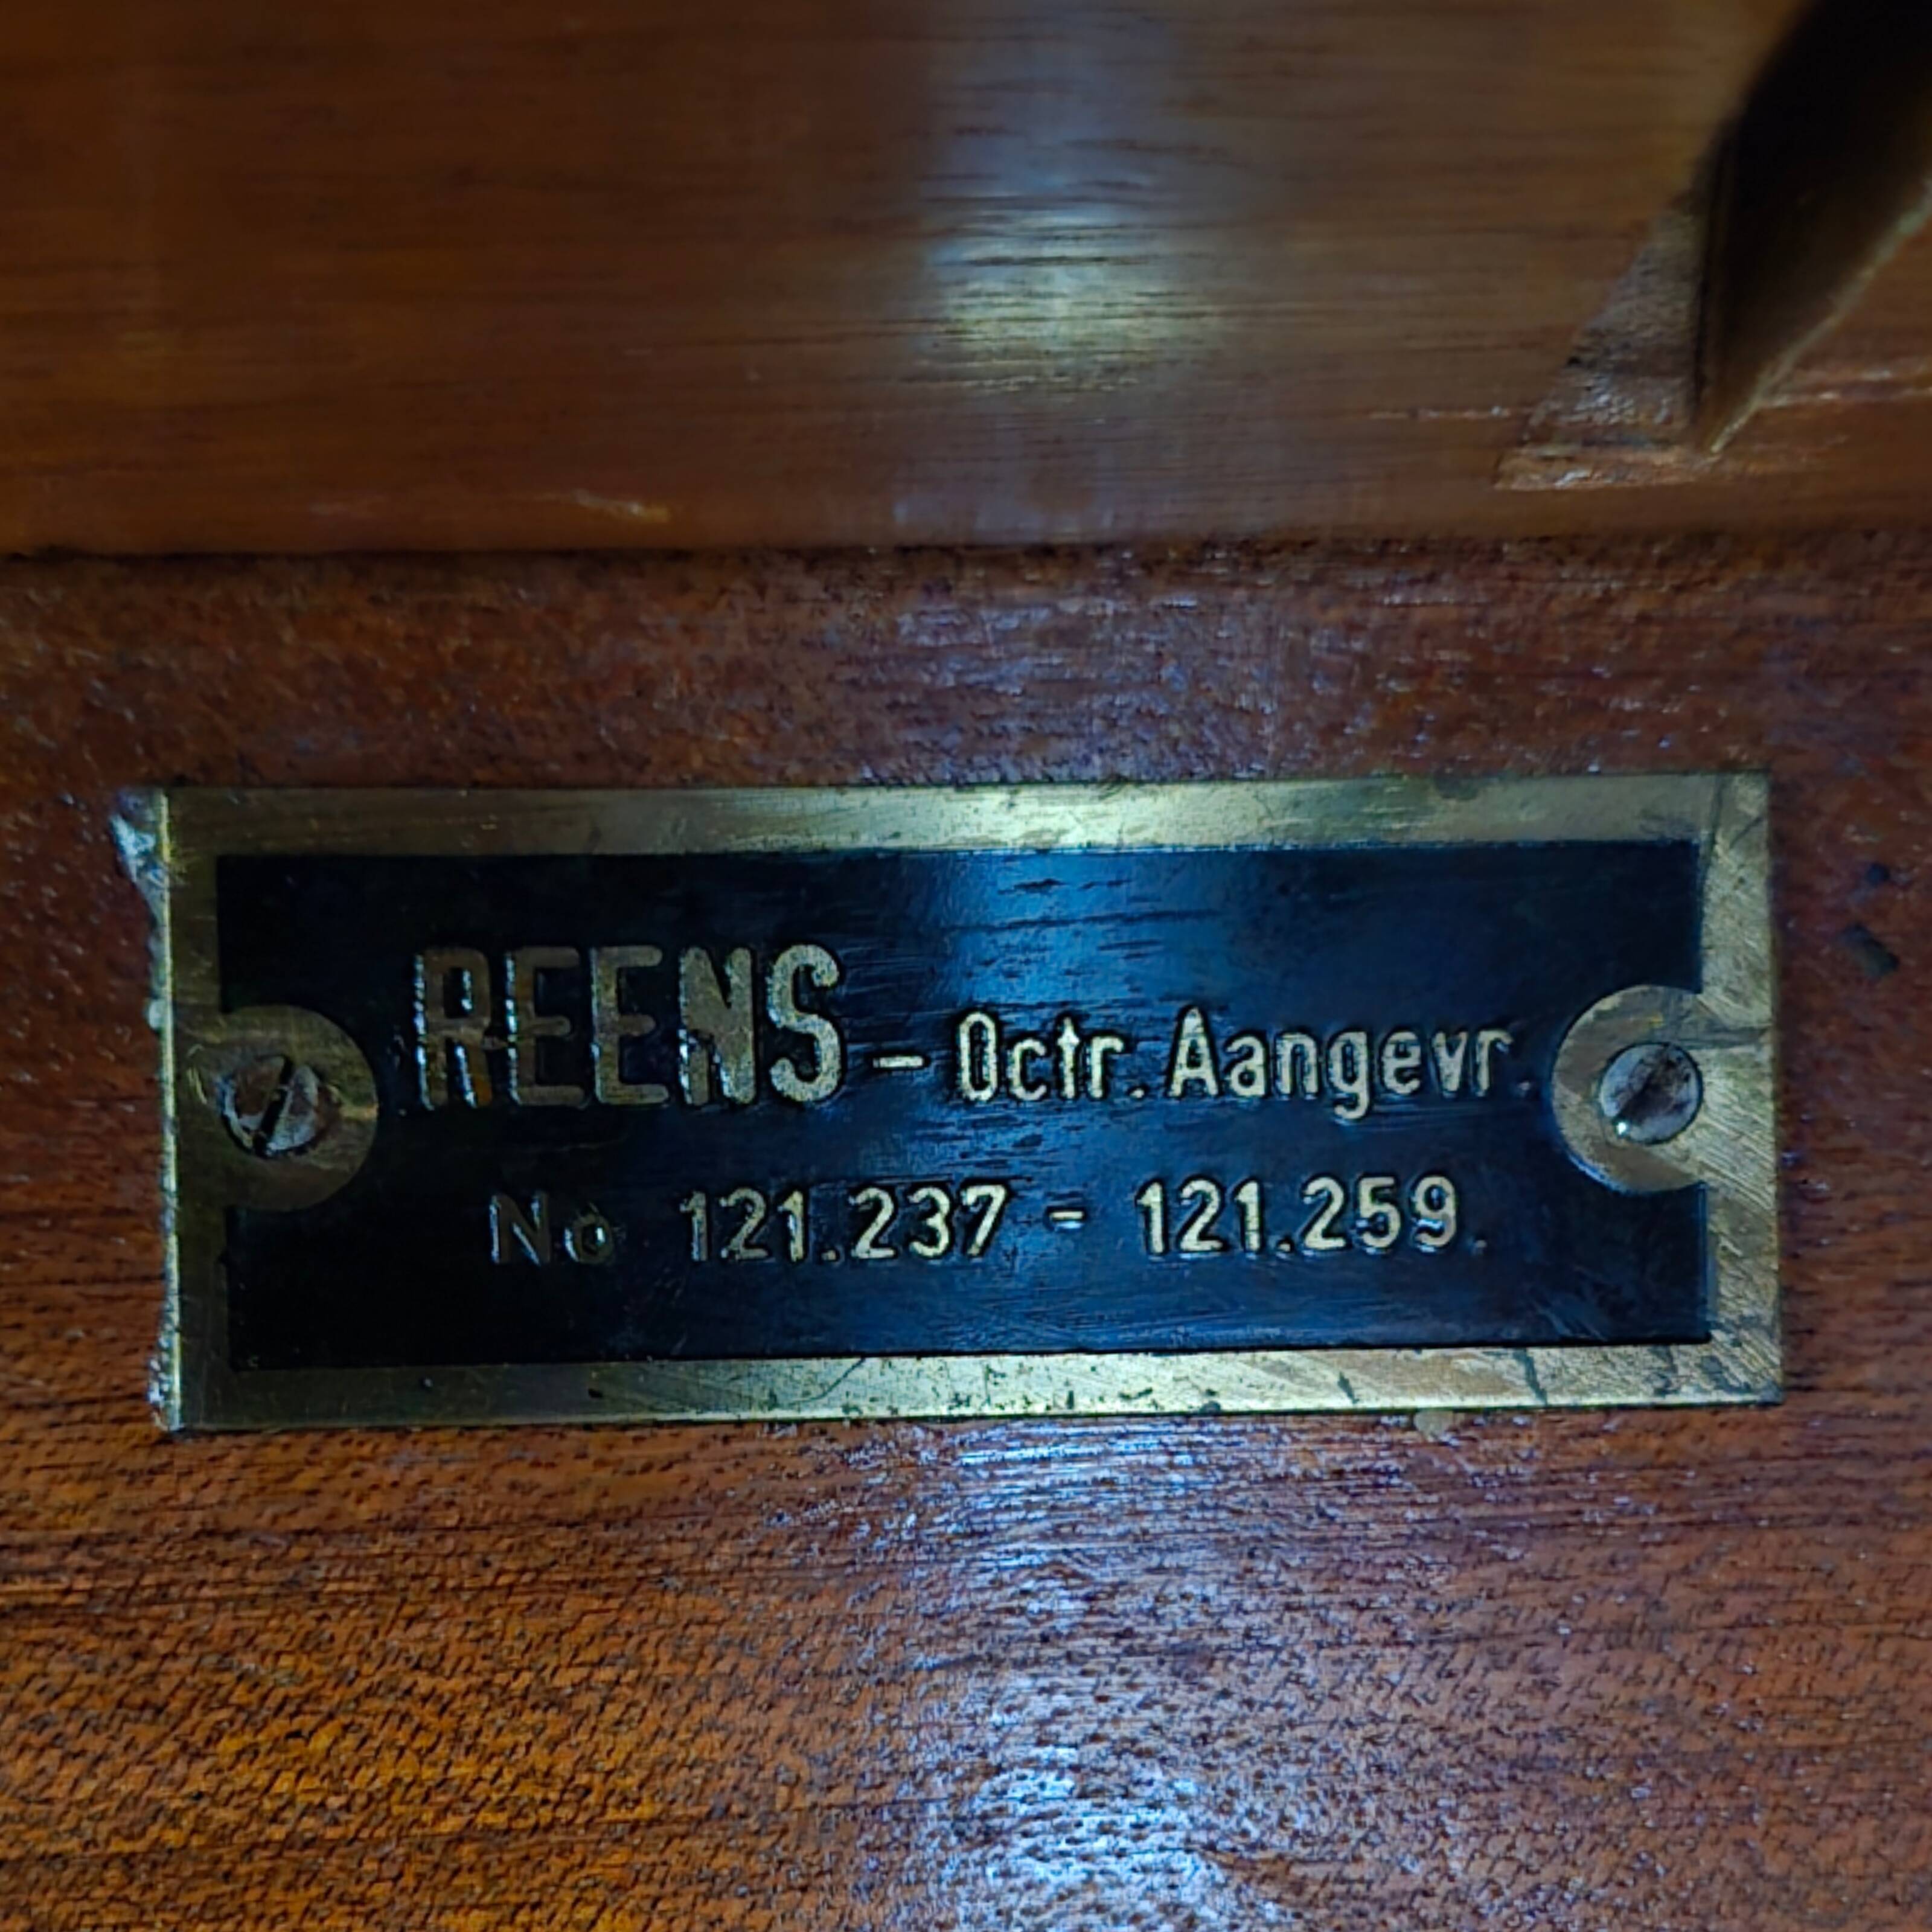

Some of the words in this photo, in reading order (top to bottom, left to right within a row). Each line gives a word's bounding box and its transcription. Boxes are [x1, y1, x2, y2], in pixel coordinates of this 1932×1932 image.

[413, 943, 844, 1110] REENS
[1168, 1005, 1534, 1122] Aangevr.
[489, 1191, 613, 1264] No
[680, 1182, 1011, 1261] 121.237
